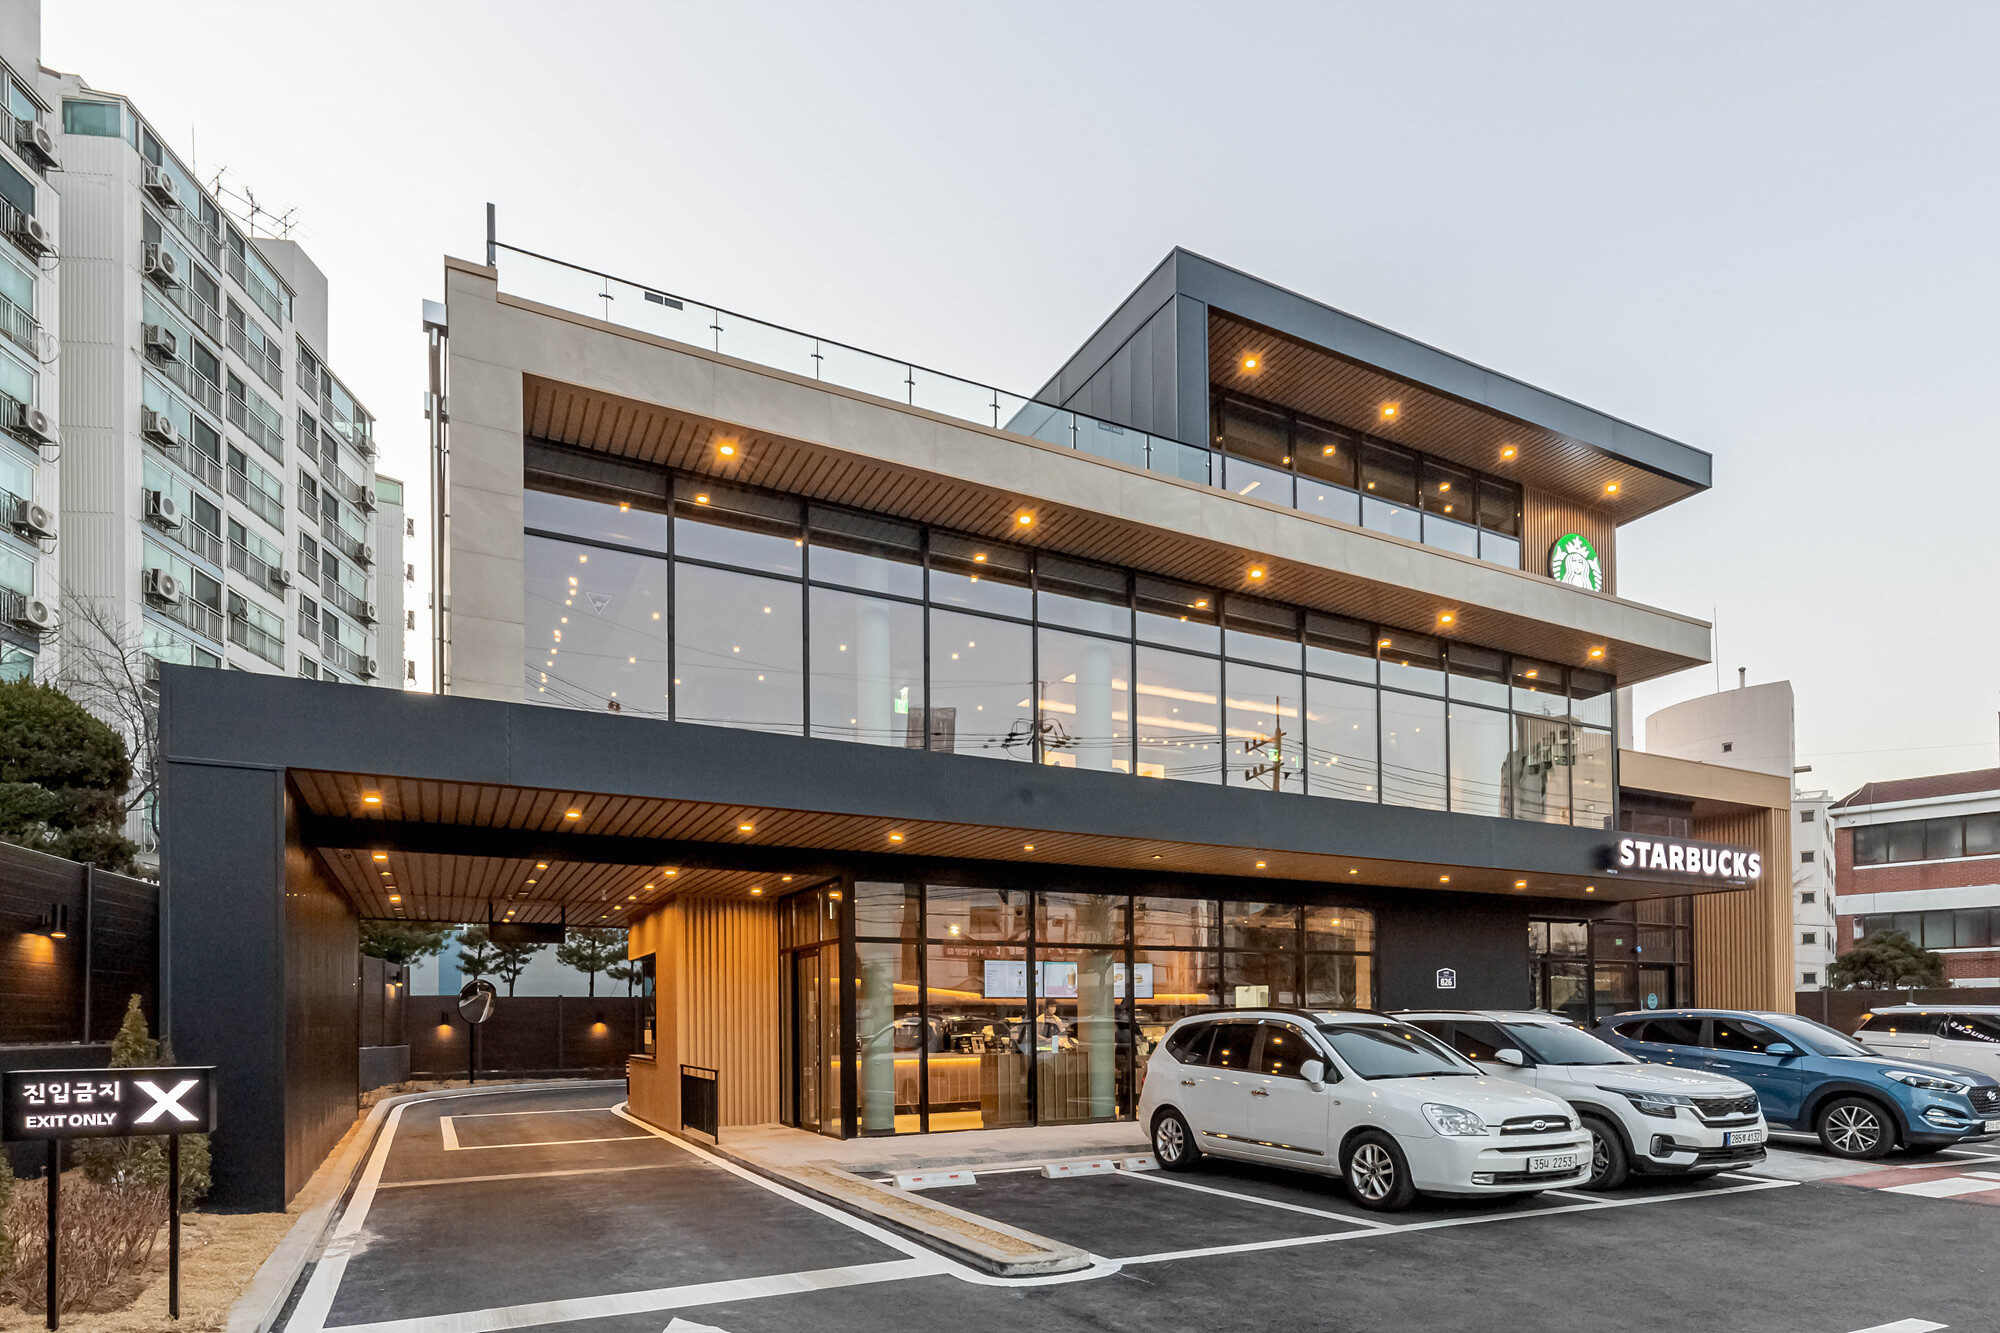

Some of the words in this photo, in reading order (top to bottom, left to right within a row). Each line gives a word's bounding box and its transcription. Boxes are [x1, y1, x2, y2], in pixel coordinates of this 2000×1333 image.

[1620, 839, 1761, 879] STARBUCKS
[23, 1081, 120, 1104] 진입금지
[26, 1114, 67, 1128] EXIT
[69, 1112, 117, 1126] ONLY
[1553, 1156, 1573, 1169] 2253
